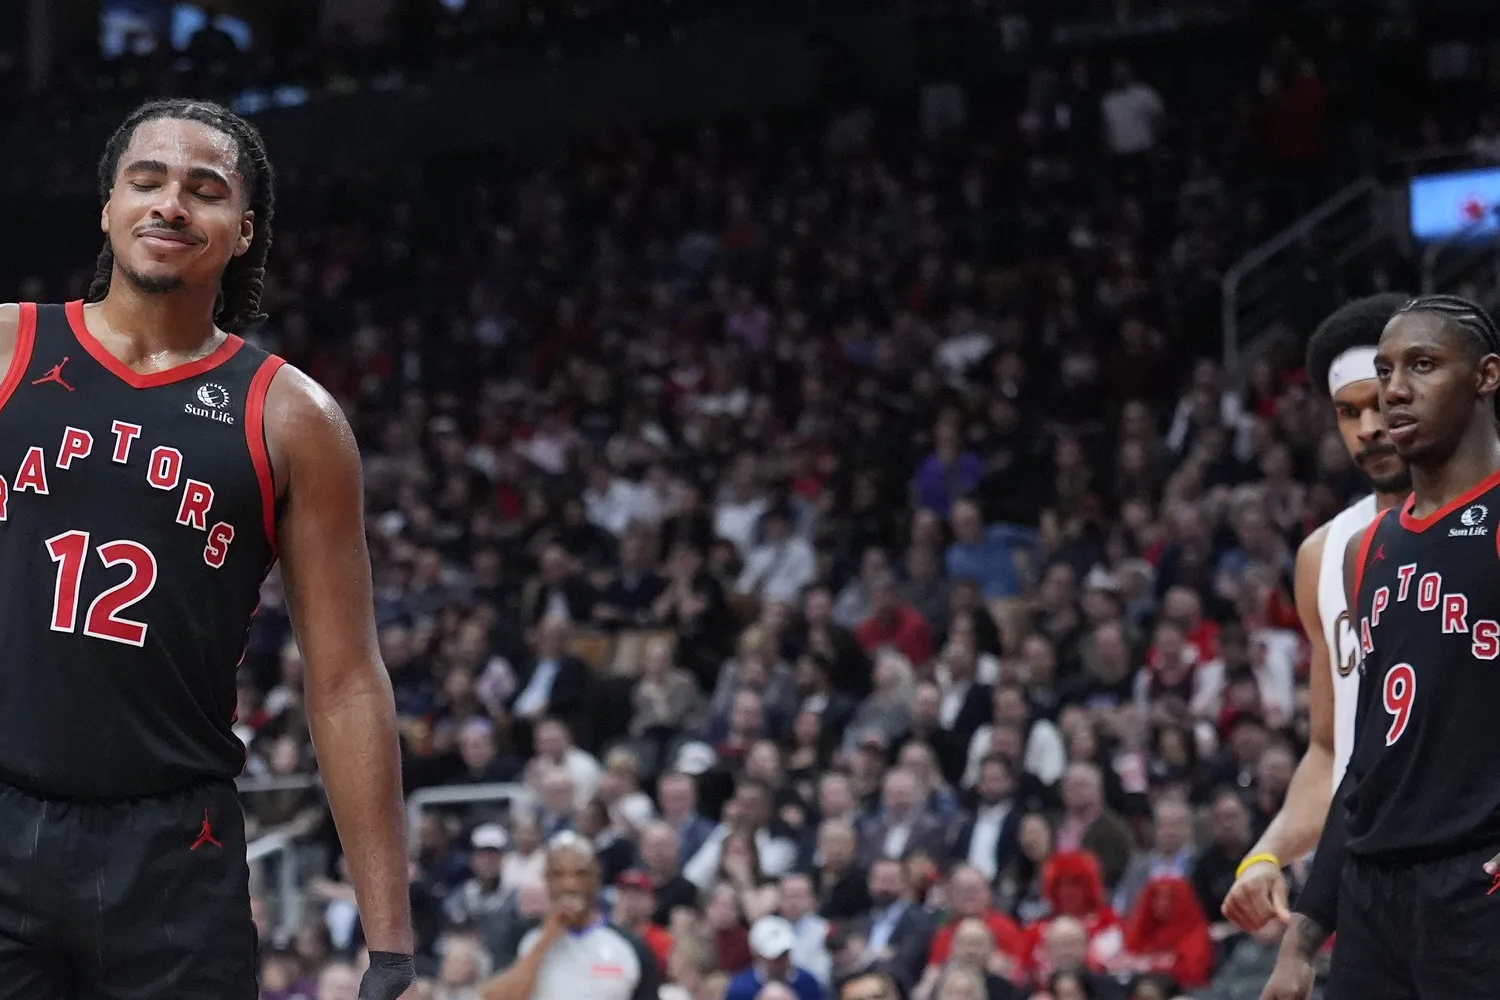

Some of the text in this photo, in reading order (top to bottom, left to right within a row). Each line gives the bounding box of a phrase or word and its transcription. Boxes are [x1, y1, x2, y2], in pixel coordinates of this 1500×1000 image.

[184, 403, 235, 425] Sun Life
[1448, 526, 1488, 537] Sun Life
[44, 529, 158, 648] 12
[1358, 562, 1500, 660] APTORS
[1383, 662, 1417, 747] 9
